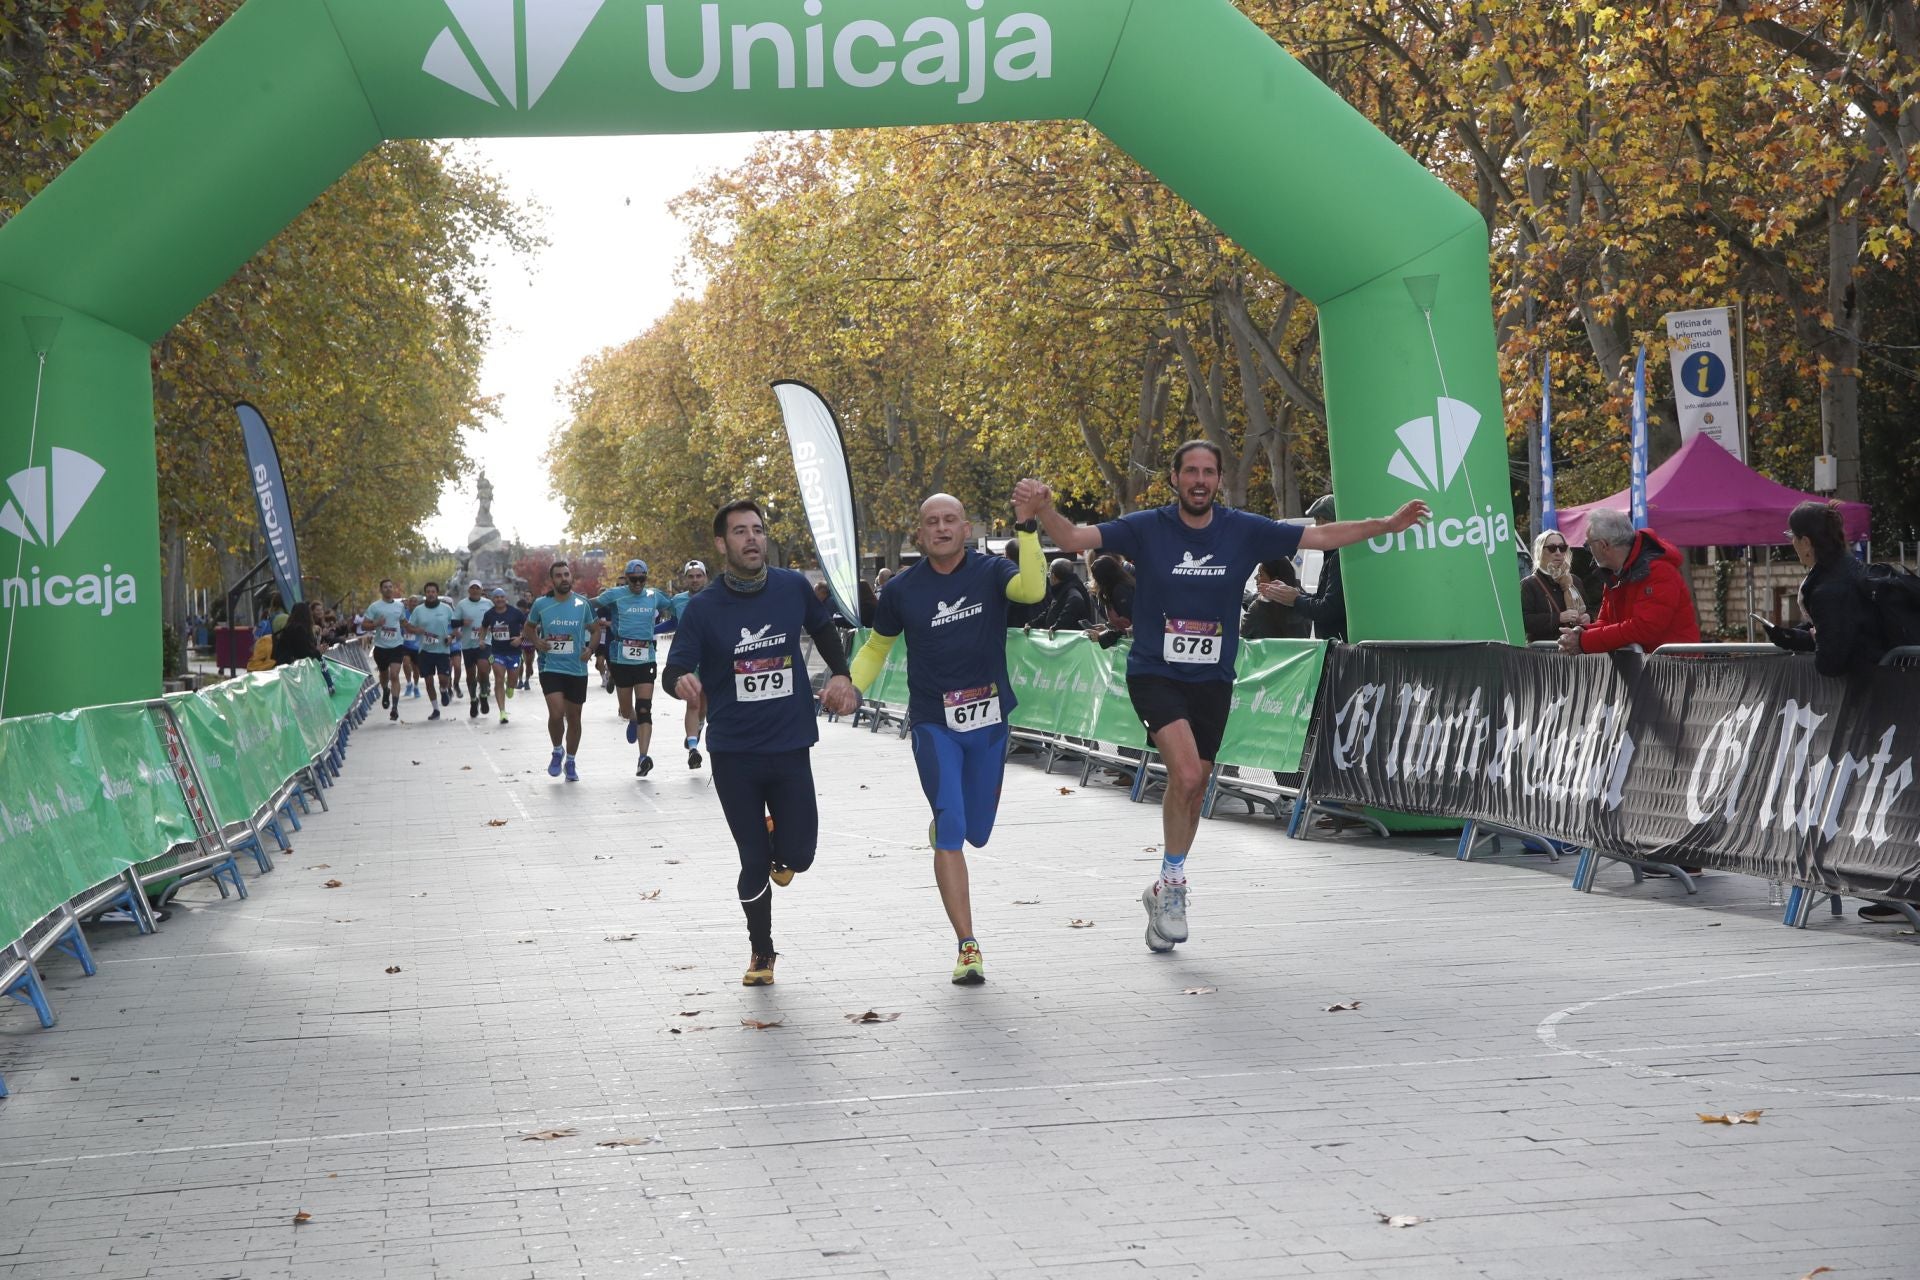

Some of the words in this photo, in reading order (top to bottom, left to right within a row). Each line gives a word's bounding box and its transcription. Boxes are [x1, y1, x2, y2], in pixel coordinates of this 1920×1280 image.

[646, 0, 1052, 104] Unicaja
[1674, 319, 1701, 329] Oficina
[1702, 318, 1712, 326] de
[1684, 340, 1711, 350] rística
[1172, 567, 1226, 576] MICHELIN
[2, 563, 137, 616] nicaja
[550, 619, 579, 627] ADIENT
[930, 605, 983, 628] MICHELIN
[553, 642, 566, 650] 27
[629, 648, 642, 656] 25
[734, 636, 786, 655] MICHELIN
[1172, 636, 1213, 655] 678
[743, 672, 784, 693] 679
[954, 700, 991, 724] 677
[1333, 682, 1386, 774] El
[1386, 682, 1490, 783] Norte
[1686, 701, 1765, 826] El
[1759, 698, 1914, 850] Norte
